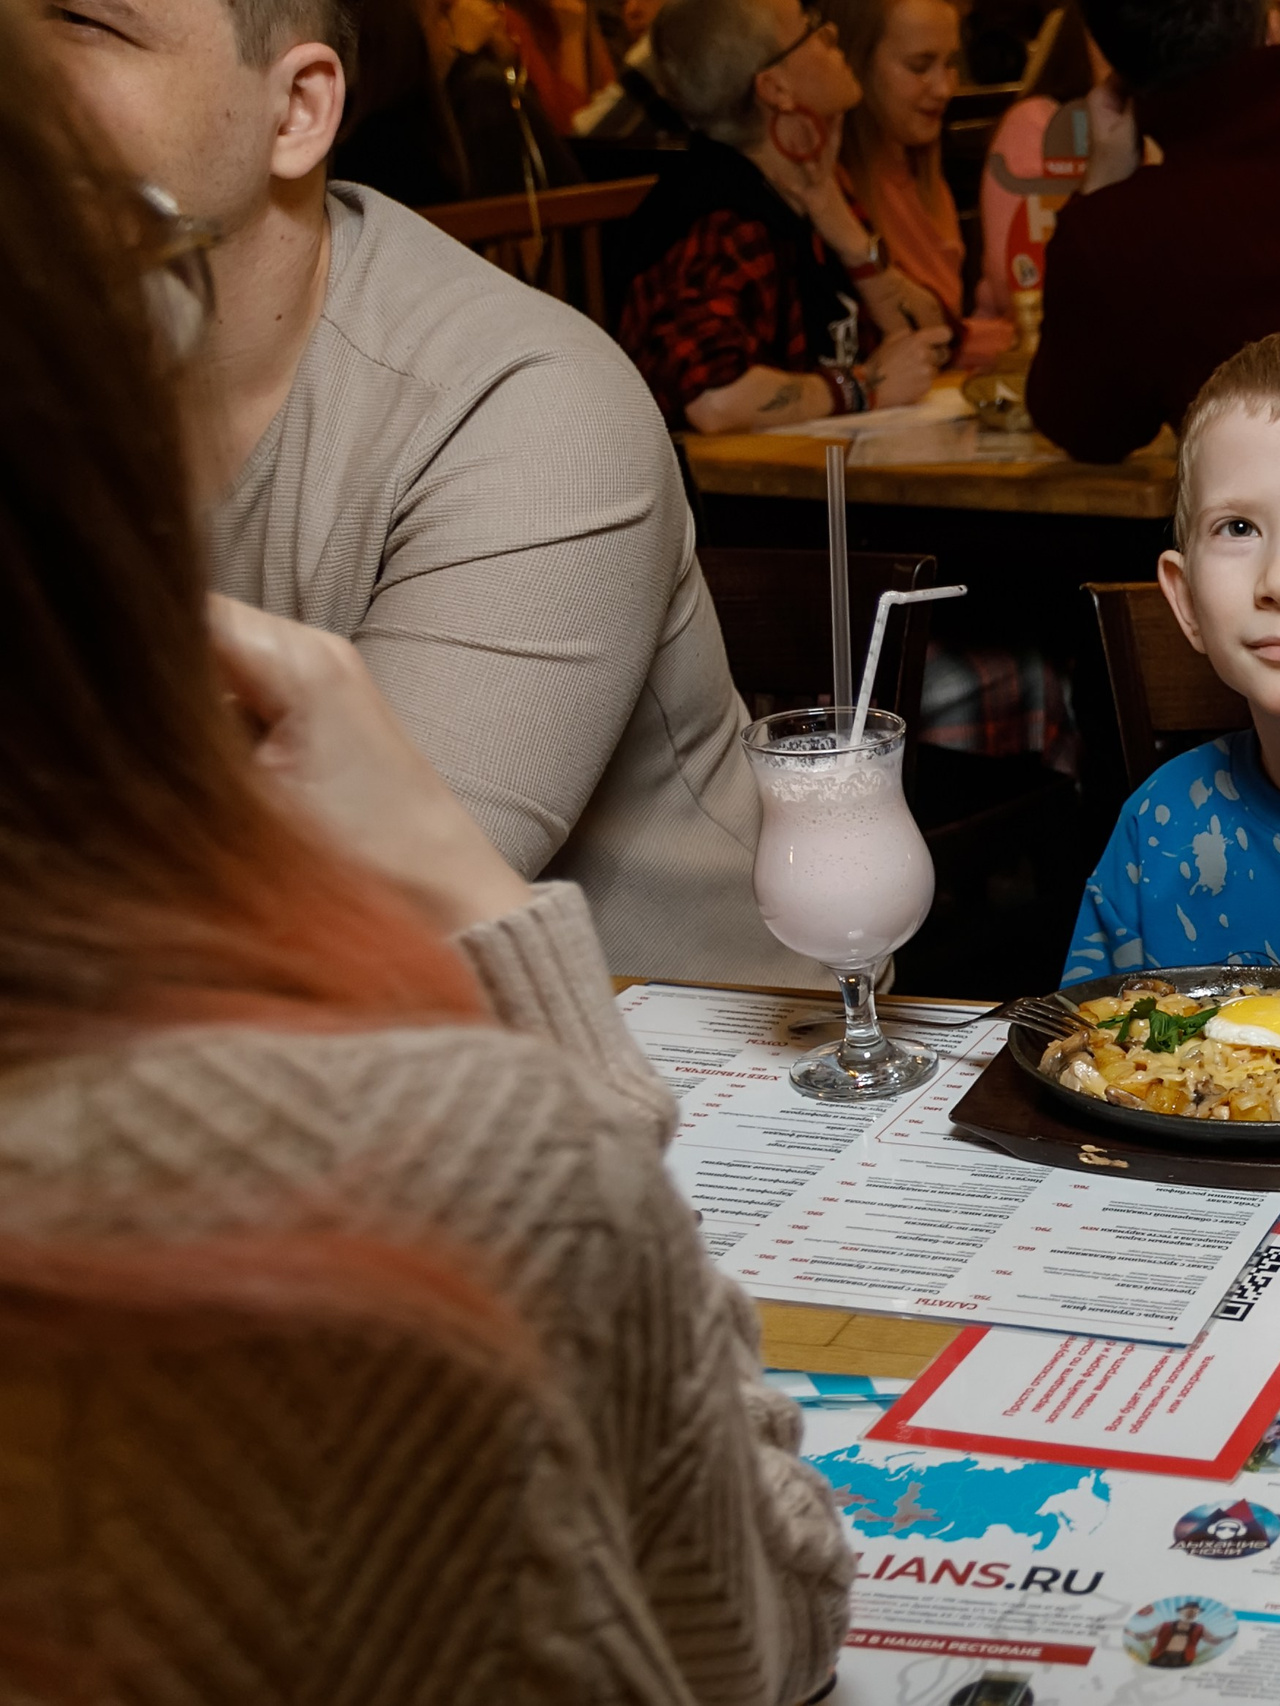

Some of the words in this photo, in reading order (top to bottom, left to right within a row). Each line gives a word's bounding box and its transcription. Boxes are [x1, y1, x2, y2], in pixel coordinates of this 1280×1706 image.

[745, 1038, 788, 1047] СОУСЫ
[674, 1066, 735, 1077] ВЫПЕЧКА
[748, 1073, 780, 1081] ХЛЕБ
[1156, 1187, 1206, 1198] ростбифом
[1207, 1192, 1258, 1202] домашним
[876, 1202, 914, 1211] слабого
[1233, 1199, 1261, 1208] Стейк
[720, 1209, 769, 1218] Картофель
[1102, 1207, 1153, 1217] говядиной
[1153, 1212, 1211, 1222] обжаренной
[904, 1220, 968, 1231] по-грузински
[1219, 1218, 1246, 1226] Салат
[969, 1226, 996, 1234] Салат
[894, 1234, 955, 1246] по-баварски
[956, 1241, 983, 1249] Салат
[1148, 1238, 1193, 1246] жареным
[1050, 1249, 1116, 1260] баклажанами
[810, 1259, 865, 1270] бужениной
[931, 1256, 969, 1264] Теплый
[1118, 1256, 1178, 1266] хрустящими
[901, 1269, 954, 1279] Фасолевый
[814, 1277, 868, 1287] говядиной
[911, 1287, 940, 1295] Салат
[1144, 1285, 1196, 1295] Греческий
[914, 1298, 978, 1311] САЛАТЫ
[1061, 1304, 1086, 1313] филе
[1088, 1306, 1135, 1316] куриным
[1143, 1312, 1178, 1322] Цезарь
[1031, 1367, 1074, 1413] переходите
[1069, 1355, 1082, 1367] по
[1045, 1379, 1087, 1423] заполняйте
[1082, 1352, 1108, 1378] форму
[1103, 1346, 1111, 1354] и
[1071, 1391, 1098, 1419] готовы
[1093, 1355, 1126, 1393] выиграть
[1104, 1414, 1124, 1432] Вам
[1119, 1391, 1143, 1415] будет
[1138, 1354, 1171, 1393] присвоен
[1002, 1387, 1035, 1417] Просто
[1166, 1399, 1182, 1414] или
[1129, 1384, 1171, 1435] обязательно
[853, 1552, 1105, 1596] LIANS.RU
[868, 1635, 881, 1645] В
[882, 1635, 947, 1650] НАШЕМ
[947, 1640, 1043, 1657] РЕСТОРАНЕ
